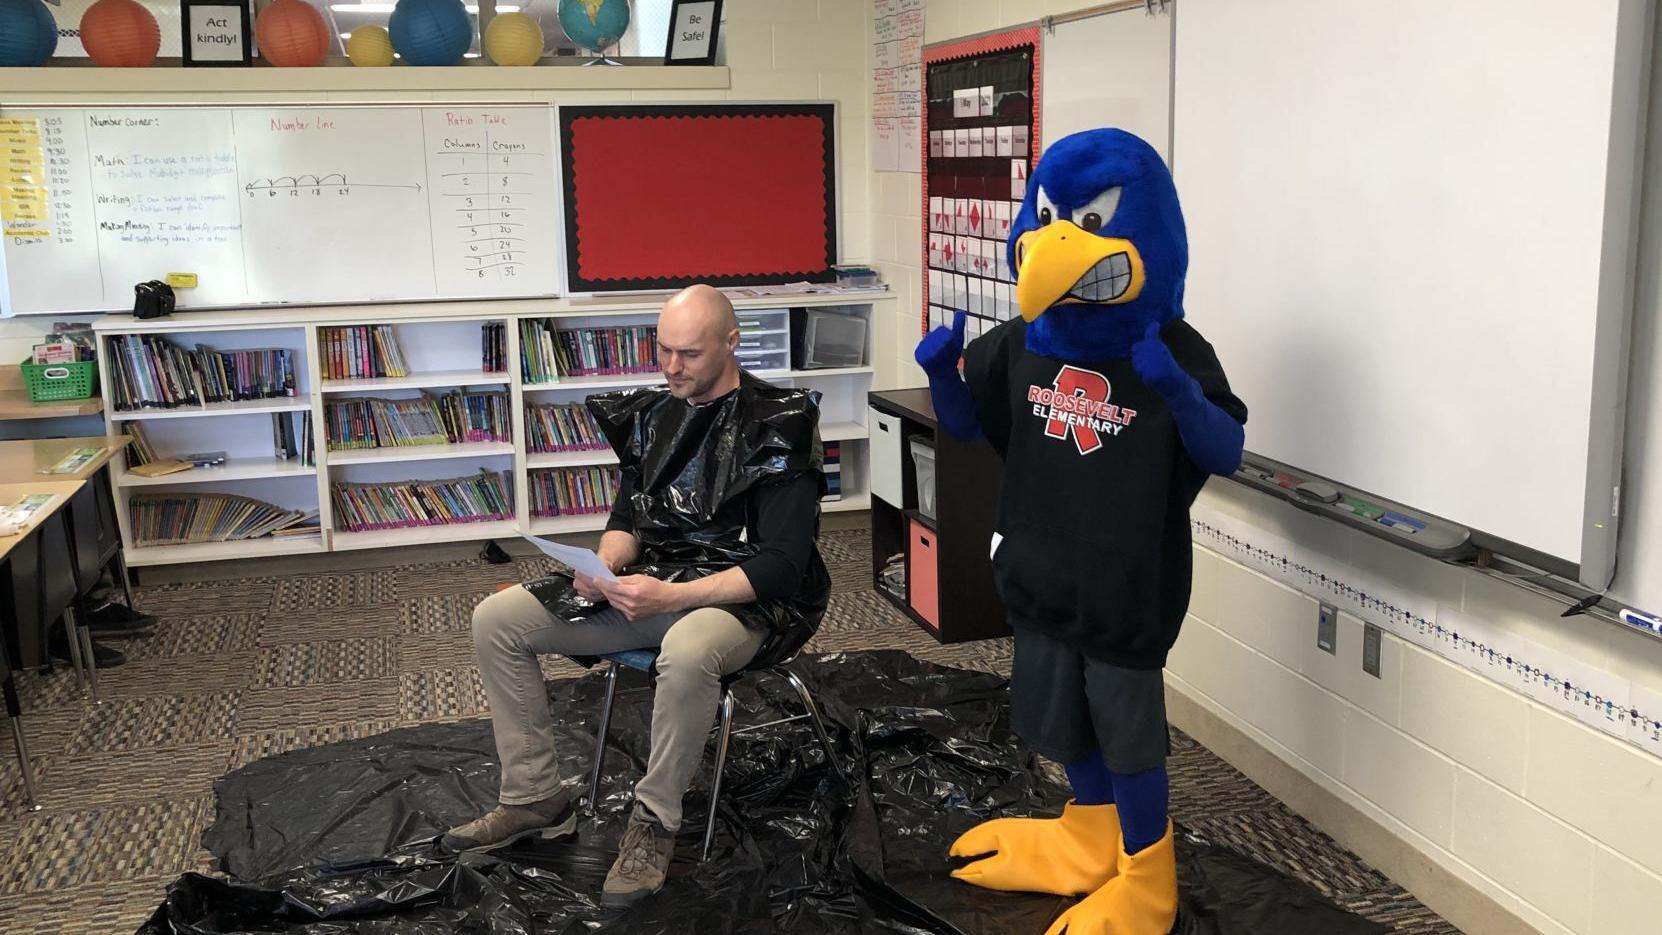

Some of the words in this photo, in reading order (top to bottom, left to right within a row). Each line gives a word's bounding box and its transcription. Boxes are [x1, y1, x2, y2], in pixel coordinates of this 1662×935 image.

[206, 18, 228, 28] Act
[689, 14, 702, 24] Be
[196, 34, 237, 46] kindly!
[682, 32, 705, 42] Safe!
[90, 116, 122, 127] Number
[446, 112, 473, 127] Ratio
[481, 114, 510, 126] Table
[270, 118, 310, 132] Number
[444, 138, 481, 149] Columns
[492, 140, 526, 152] Crayons
[503, 156, 510, 166] 4
[462, 178, 470, 186] 2
[502, 176, 508, 186] 8
[290, 188, 298, 196] 12
[312, 188, 320, 196] 18
[339, 188, 349, 196] 24
[466, 198, 472, 207] 3
[501, 196, 510, 204] 12
[466, 213, 472, 222] 4
[471, 228, 478, 236] 5
[500, 226, 512, 234] 20
[470, 244, 478, 252] 6
[500, 241, 510, 249] 24
[477, 257, 482, 266] 7
[478, 270, 484, 278] 8
[504, 266, 516, 276] 32
[1027, 384, 1137, 426] ROOSEVELT
[1044, 364, 1112, 456] R
[1032, 404, 1124, 436] ELEMENTARY
